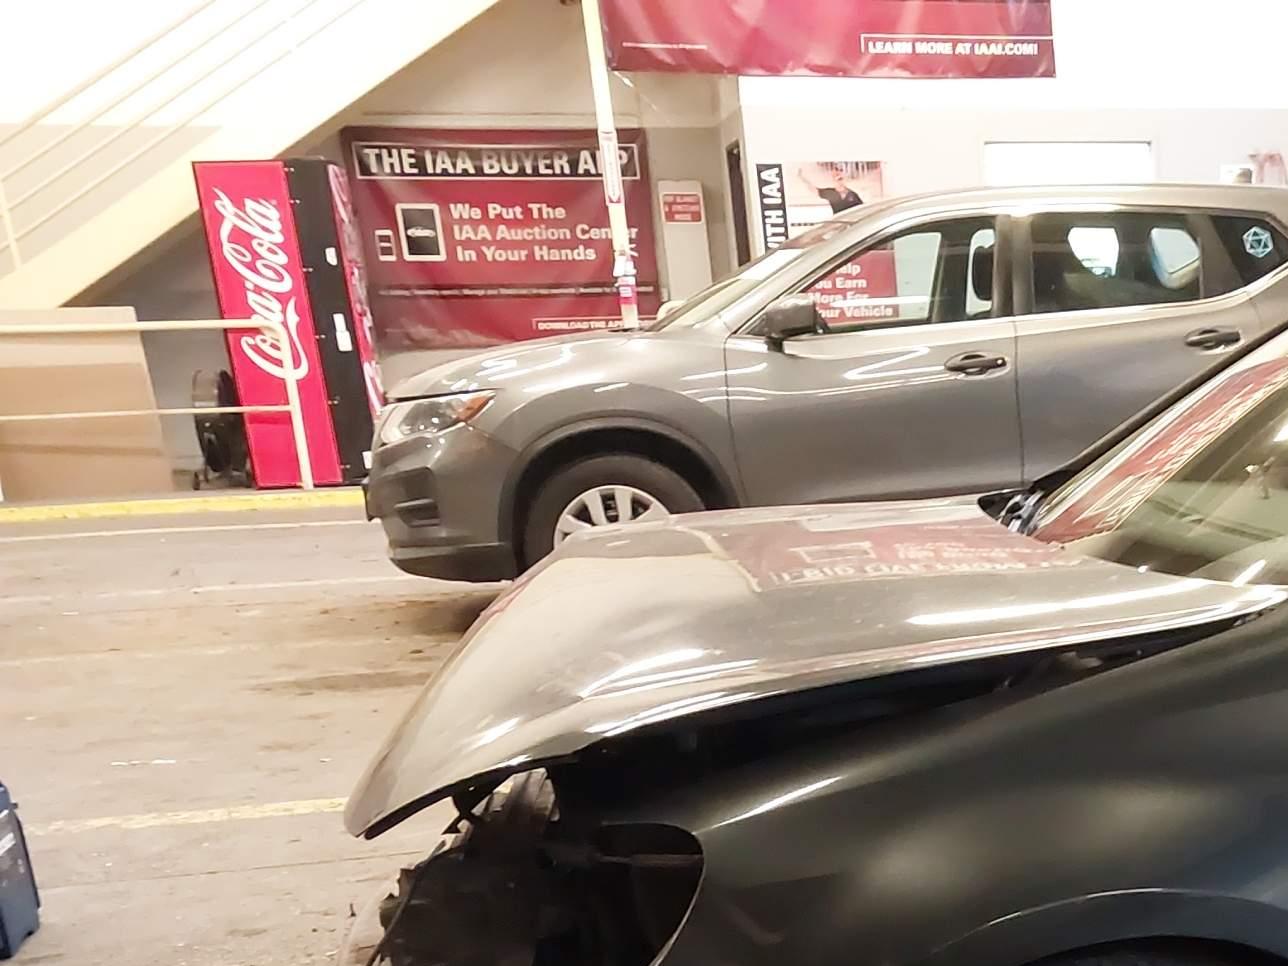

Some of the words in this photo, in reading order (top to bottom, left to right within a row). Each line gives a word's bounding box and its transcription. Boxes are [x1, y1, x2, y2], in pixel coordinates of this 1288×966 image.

[867, 41, 912, 54] LEARN
[915, 42, 953, 55] MORE
[955, 43, 972, 55] AT
[364, 148, 418, 174] THE
[424, 149, 475, 174] IAA
[481, 151, 571, 175] BUYER
[577, 150, 628, 174] AP
[759, 167, 782, 204] IAA
[450, 204, 482, 220] We
[488, 204, 522, 219] Put
[528, 203, 566, 219] The
[453, 225, 491, 241] IAA
[496, 225, 571, 240] Auction
[576, 225, 638, 240] Cenr
[456, 246, 477, 262] In
[482, 246, 528, 261] Your
[535, 245, 597, 261] Hands
[836, 263, 861, 276] elp
[813, 279, 832, 289] ou
[835, 277, 868, 289] Earn
[843, 306, 894, 318] Vehicle
